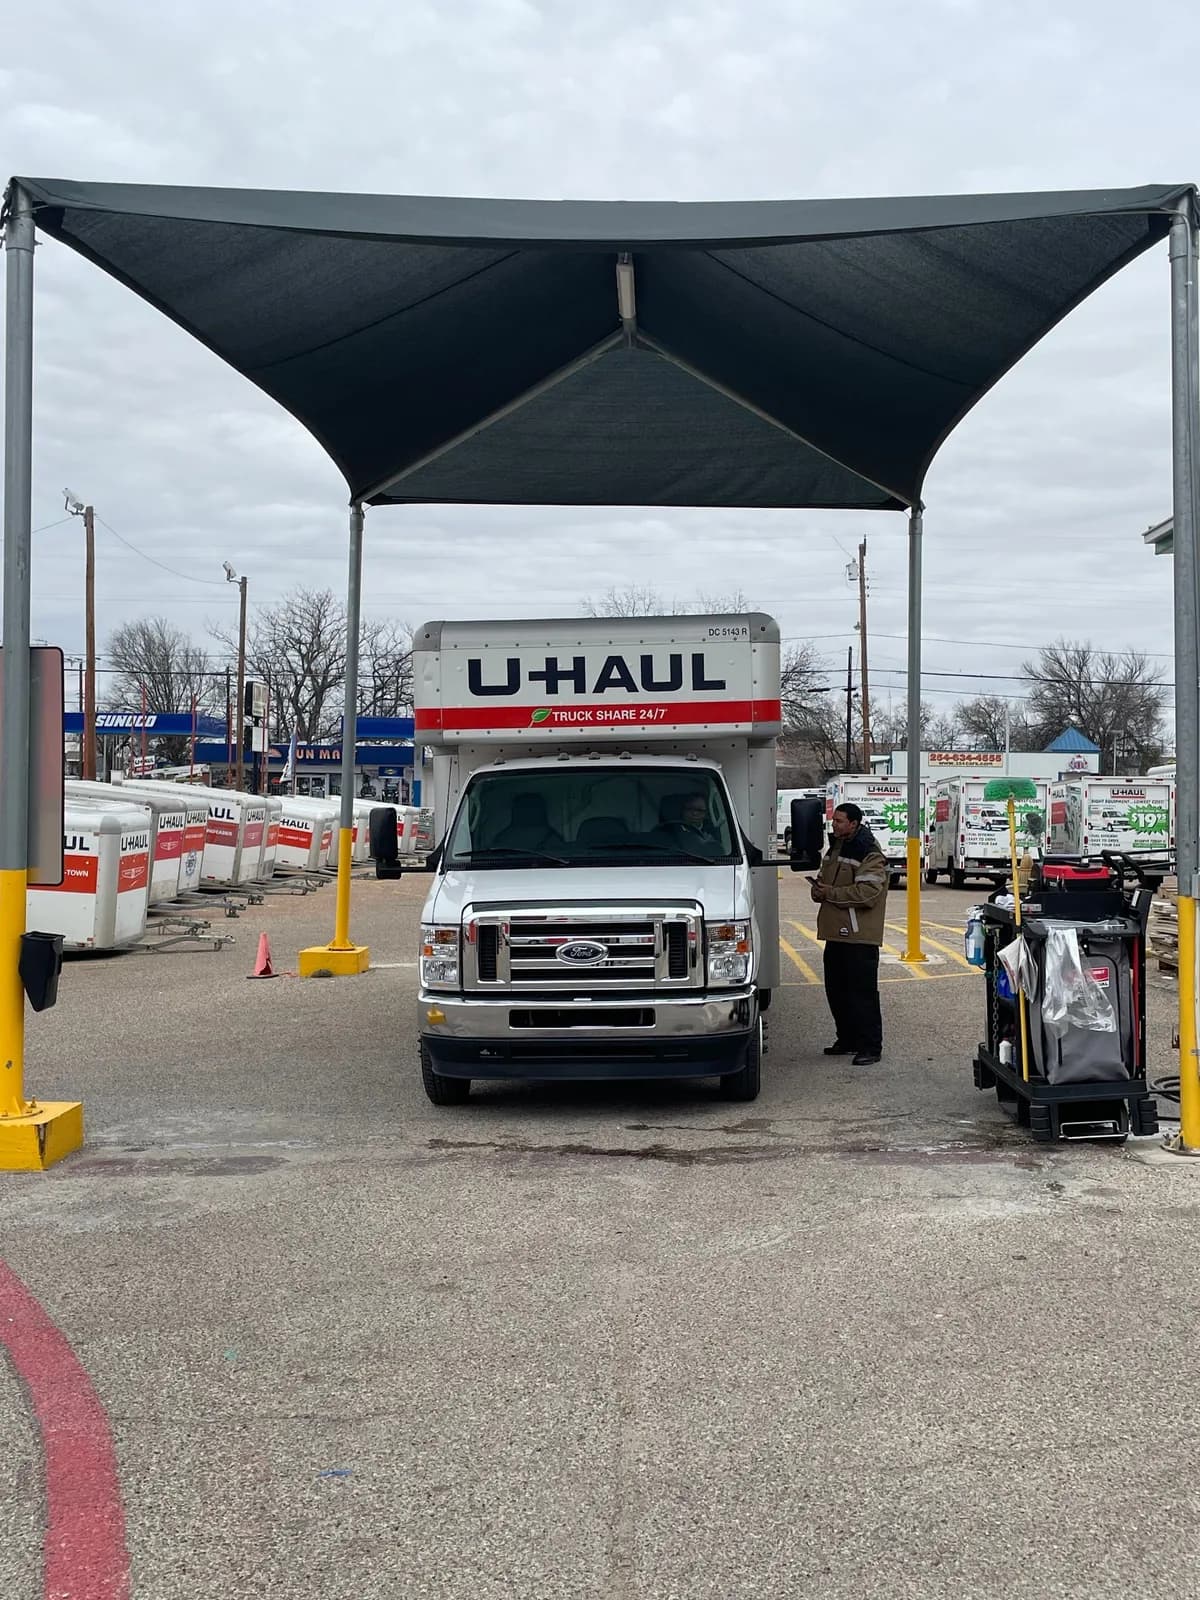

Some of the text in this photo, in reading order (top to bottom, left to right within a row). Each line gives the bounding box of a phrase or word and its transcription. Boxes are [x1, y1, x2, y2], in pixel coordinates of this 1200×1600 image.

[708, 627, 748, 636] DC 5143 R
[467, 653, 726, 696] U-HAUL
[95, 714, 158, 728] SUNOCO
[552, 707, 666, 722] TRUCK SHARE 24/7
[296, 749, 342, 760] UN MA
[159, 815, 184, 829] U-HAUL
[280, 818, 311, 830] -HAUL
[121, 834, 149, 851] U-HAUL
[64, 869, 89, 878] -TOWN
[570, 946, 593, 957] Ford
